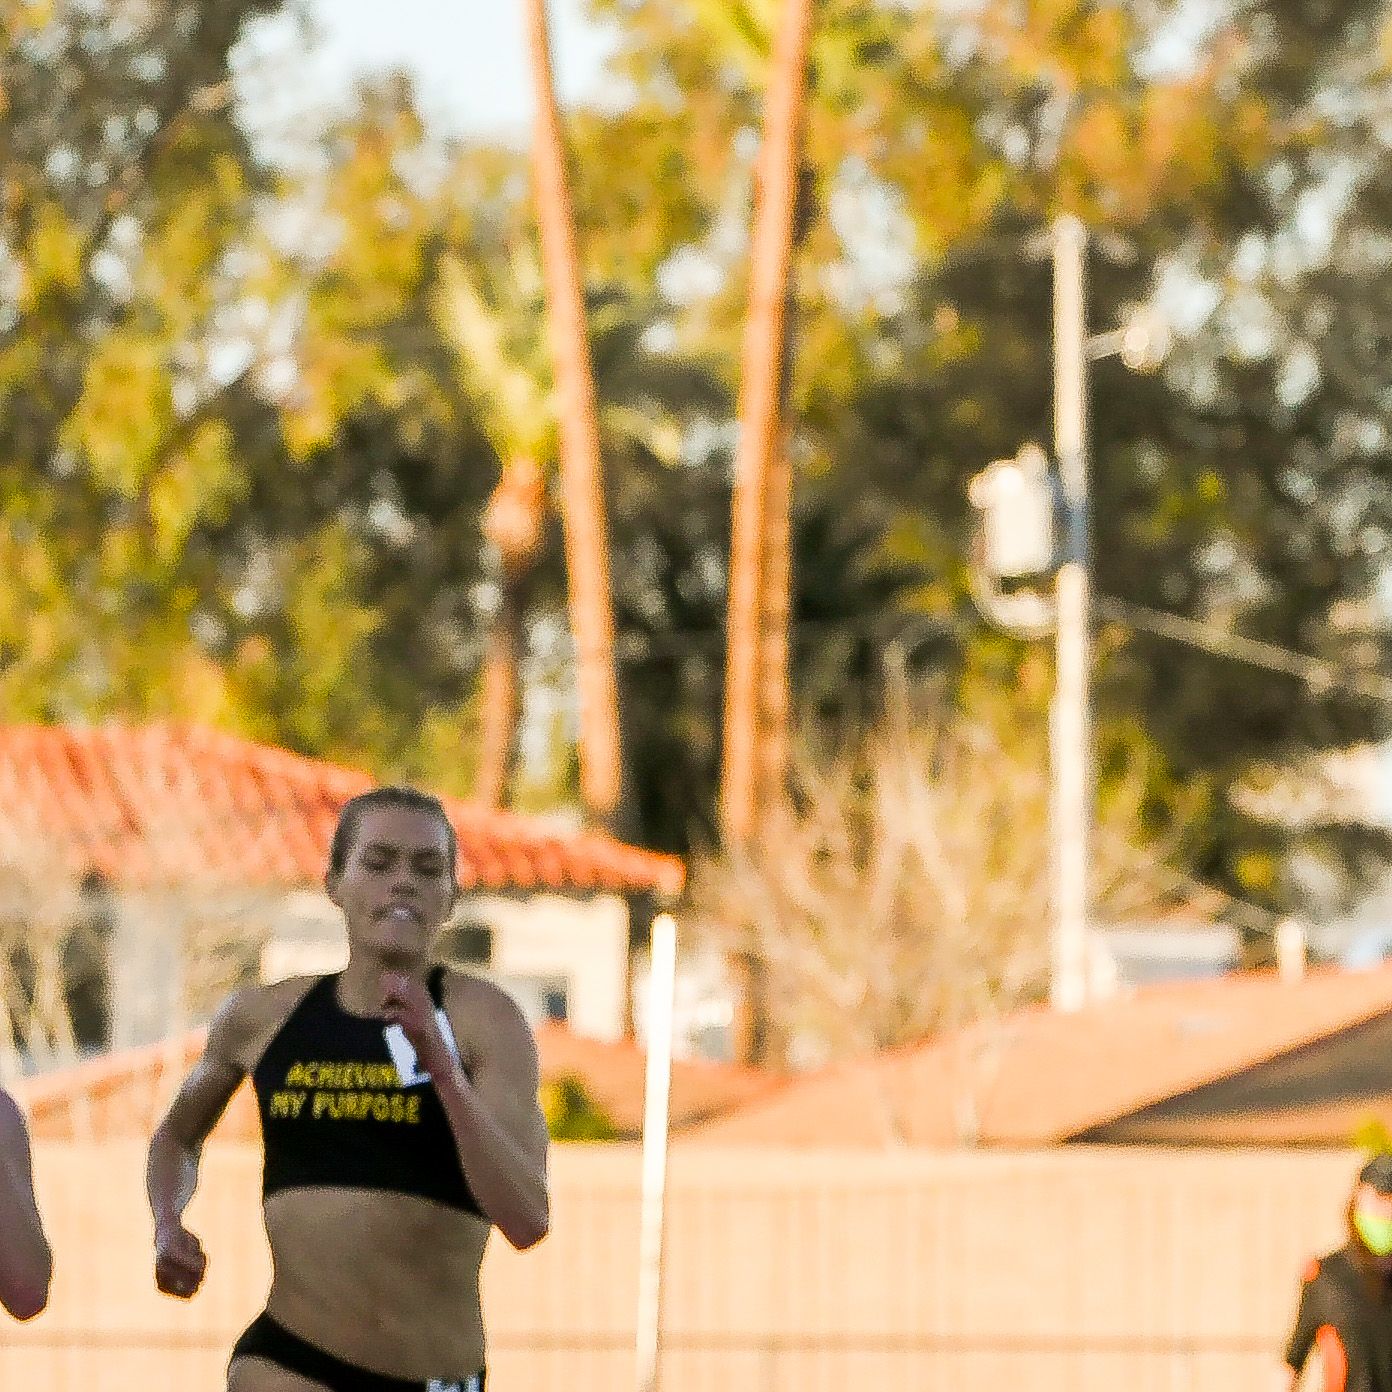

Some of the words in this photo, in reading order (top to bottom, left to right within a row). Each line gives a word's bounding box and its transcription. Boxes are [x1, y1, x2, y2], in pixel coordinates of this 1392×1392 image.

[287, 1062, 402, 1088] ACHIEVIN
[270, 1091, 306, 1119] MY
[312, 1092, 421, 1124] PURPOSE
